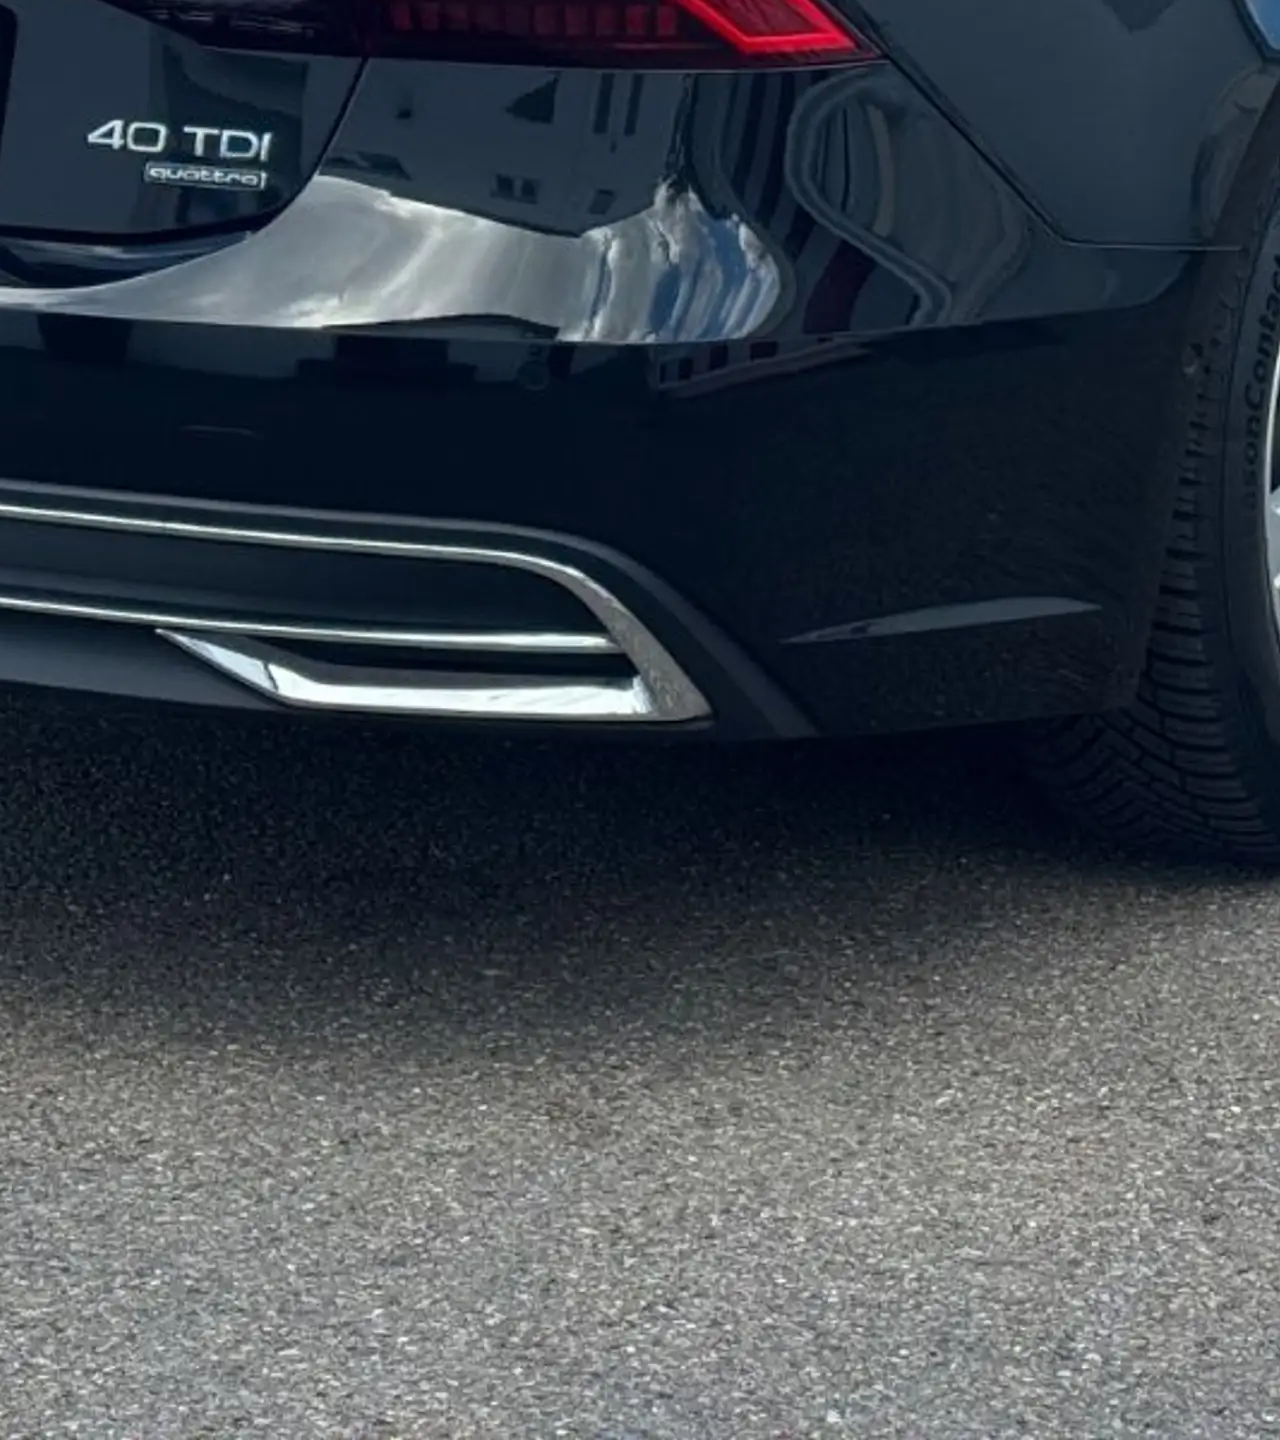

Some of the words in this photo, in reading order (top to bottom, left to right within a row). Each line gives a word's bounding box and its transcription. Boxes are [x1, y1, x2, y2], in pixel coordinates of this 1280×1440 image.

[87, 119, 168, 153] 40
[182, 125, 273, 162] TDI
[149, 166, 259, 187] quattro
